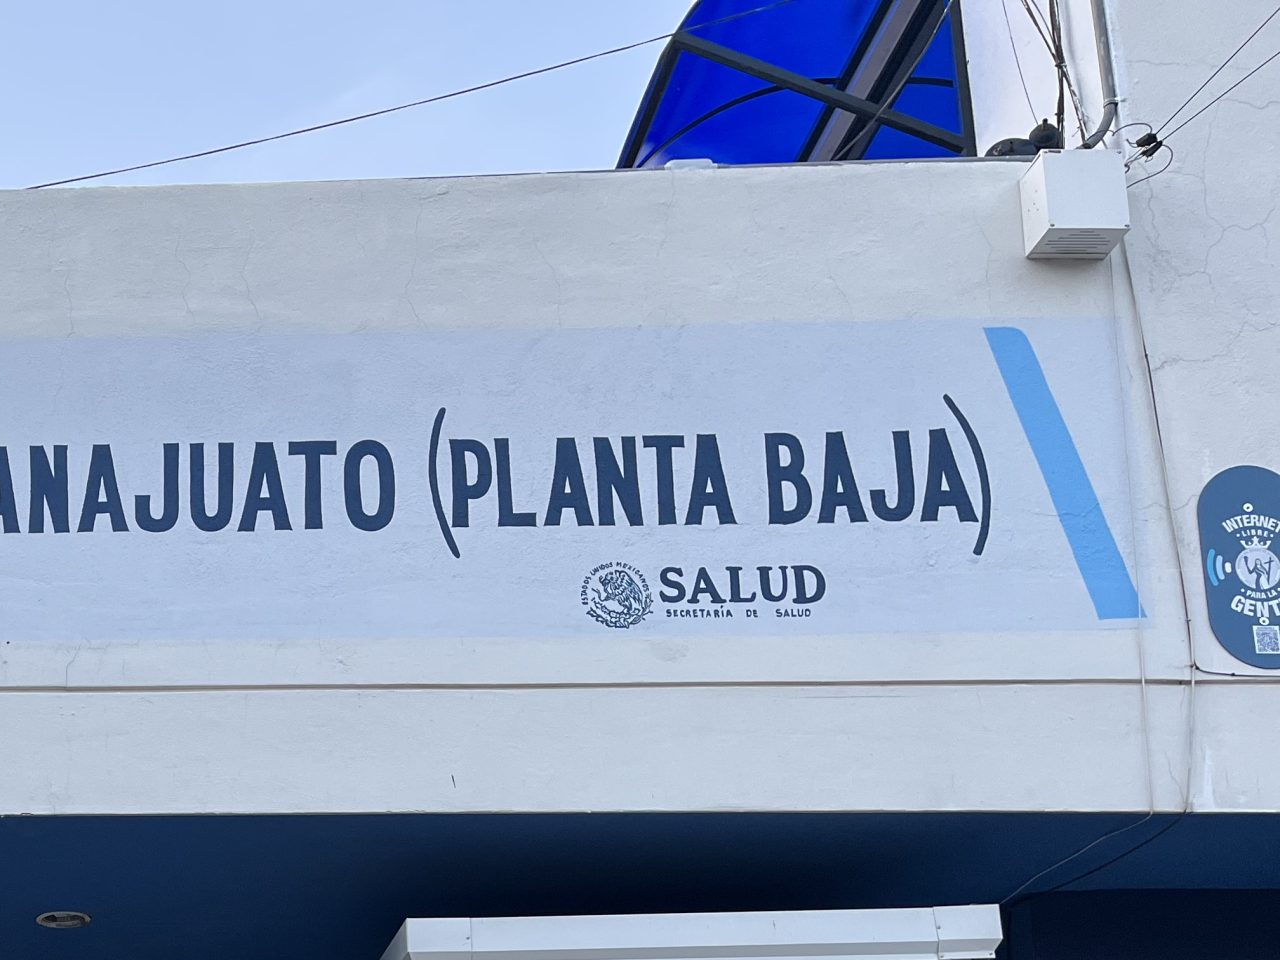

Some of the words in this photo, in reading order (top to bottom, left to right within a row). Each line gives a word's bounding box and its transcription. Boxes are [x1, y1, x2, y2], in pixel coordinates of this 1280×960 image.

[428, 407, 738, 558] (PLANTA
[764, 393, 992, 556] BAJA)
[1241, 529, 1268, 537] LIBRE
[659, 565, 826, 604] SALUD
[1246, 590, 1266, 599] PARA
[1266, 589, 1277, 598] LA
[666, 605, 733, 618] SECRETARÍA
[746, 609, 759, 618] DE
[776, 608, 811, 618] SALUD
